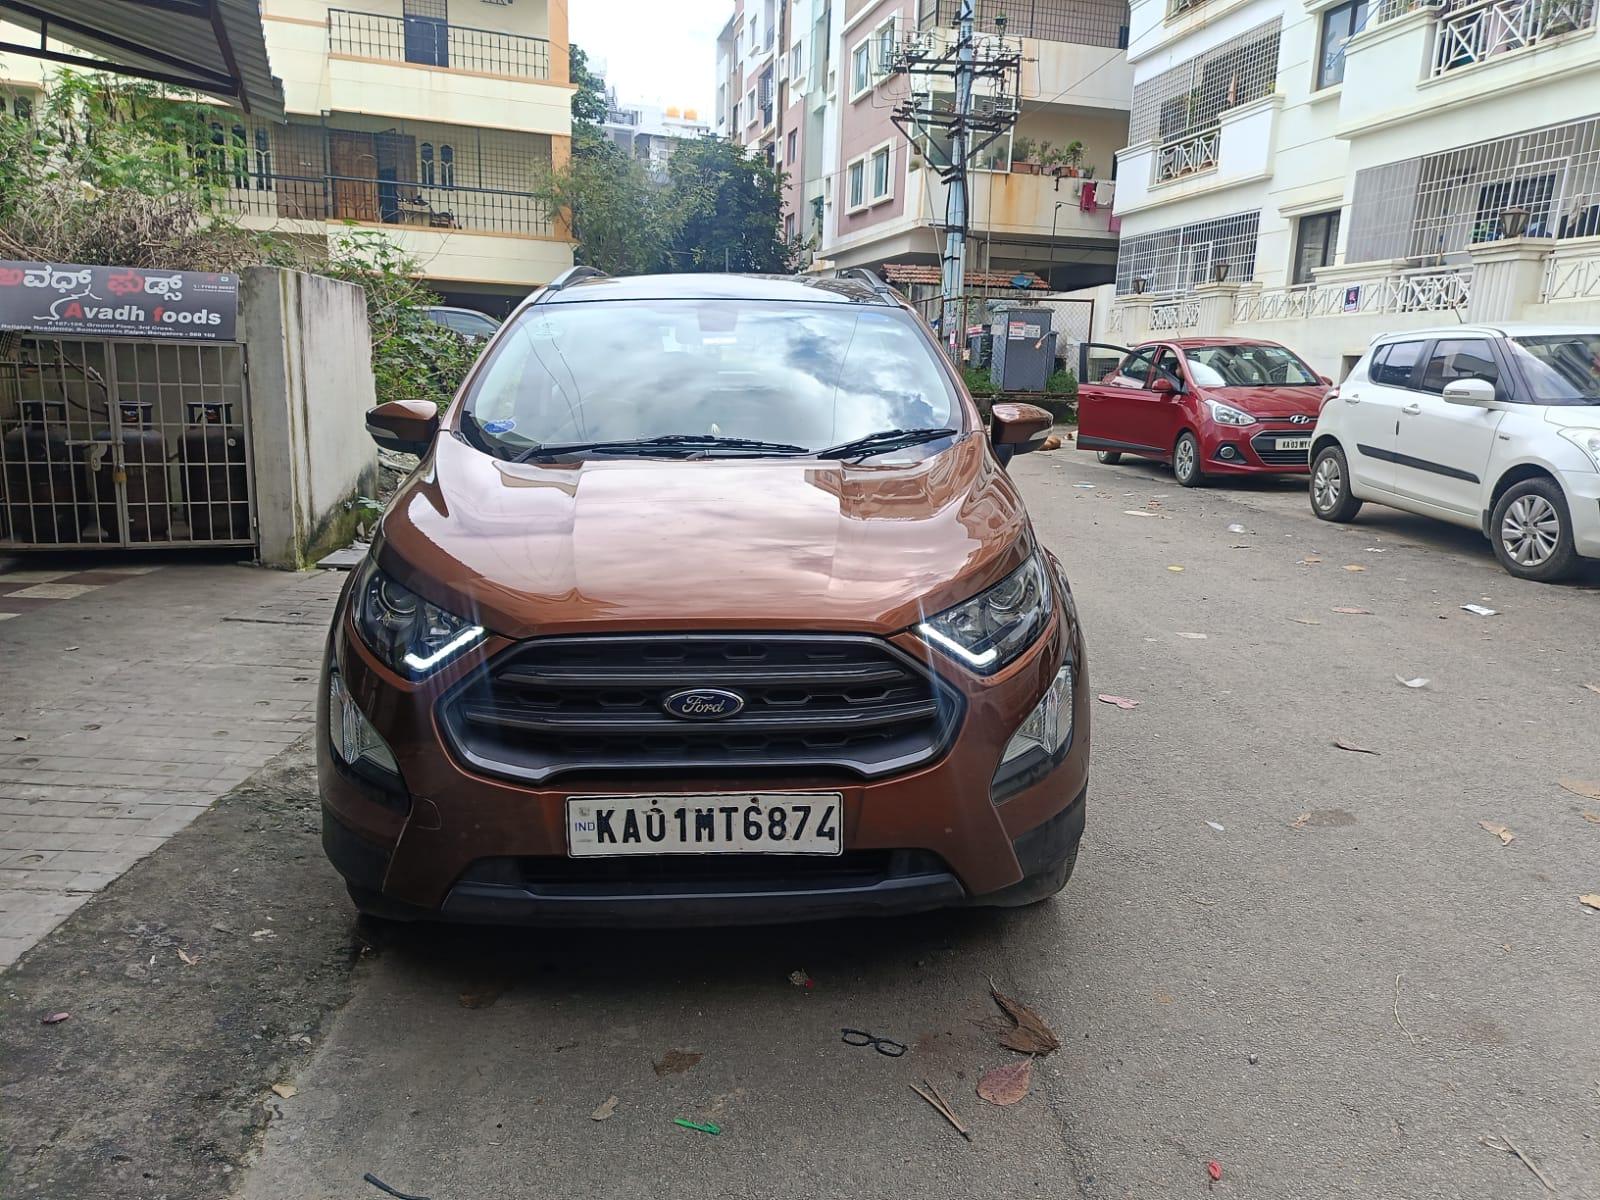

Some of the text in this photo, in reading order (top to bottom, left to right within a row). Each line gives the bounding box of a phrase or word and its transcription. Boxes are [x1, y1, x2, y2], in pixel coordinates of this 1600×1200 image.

[64, 302, 222, 325] Avadh foods
[682, 695, 726, 713] Ford
[575, 805, 836, 843] IND KA01MT6874
